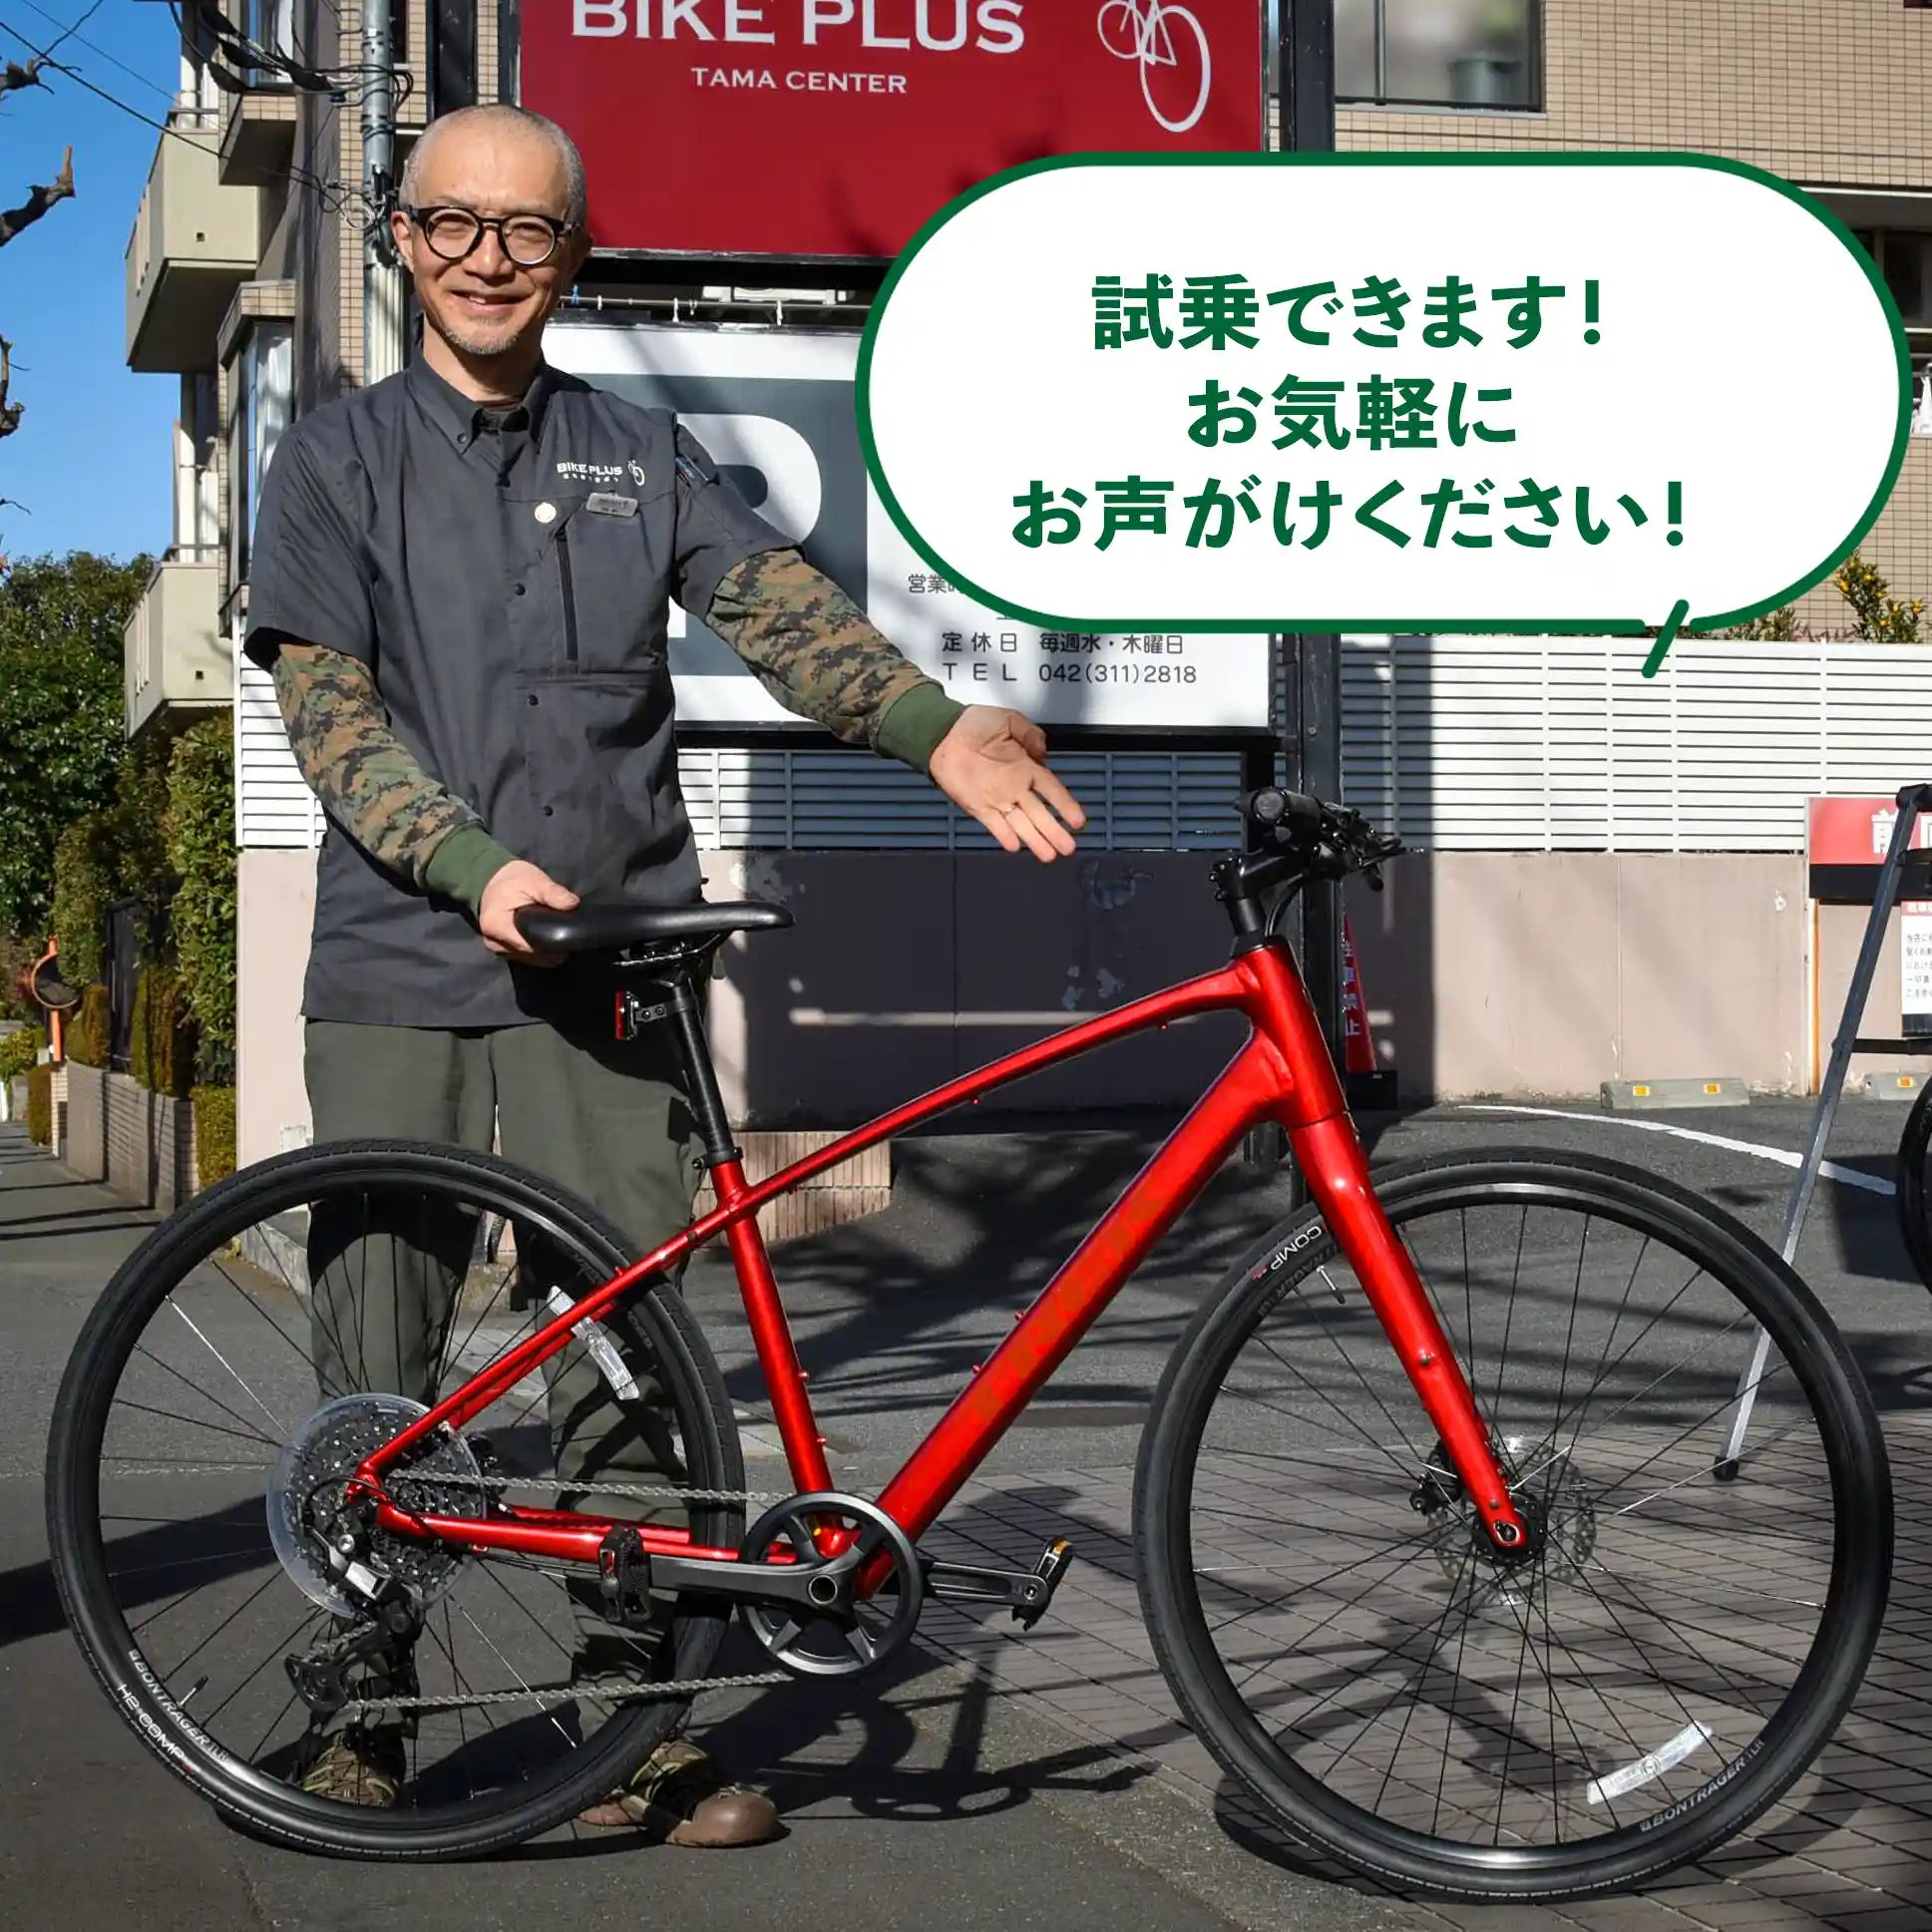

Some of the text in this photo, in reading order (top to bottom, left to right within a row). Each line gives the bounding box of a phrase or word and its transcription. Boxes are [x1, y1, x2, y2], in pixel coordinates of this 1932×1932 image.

[572, 0, 1025, 54] BIKE PLUS
[690, 67, 908, 95] TAMA CENTER
[557, 461, 623, 477] BIKE PLUS
[908, 574, 956, 593] 営業
[941, 631, 1017, 653] 定休日
[1038, 663, 1198, 684] 042(311)2818
[1270, 1226, 1323, 1271] COMP
[134, 1660, 211, 1748] BONTRAGER
[139, 1713, 188, 1759] COMP
[1652, 1757, 1746, 1827] BONTRAGER
